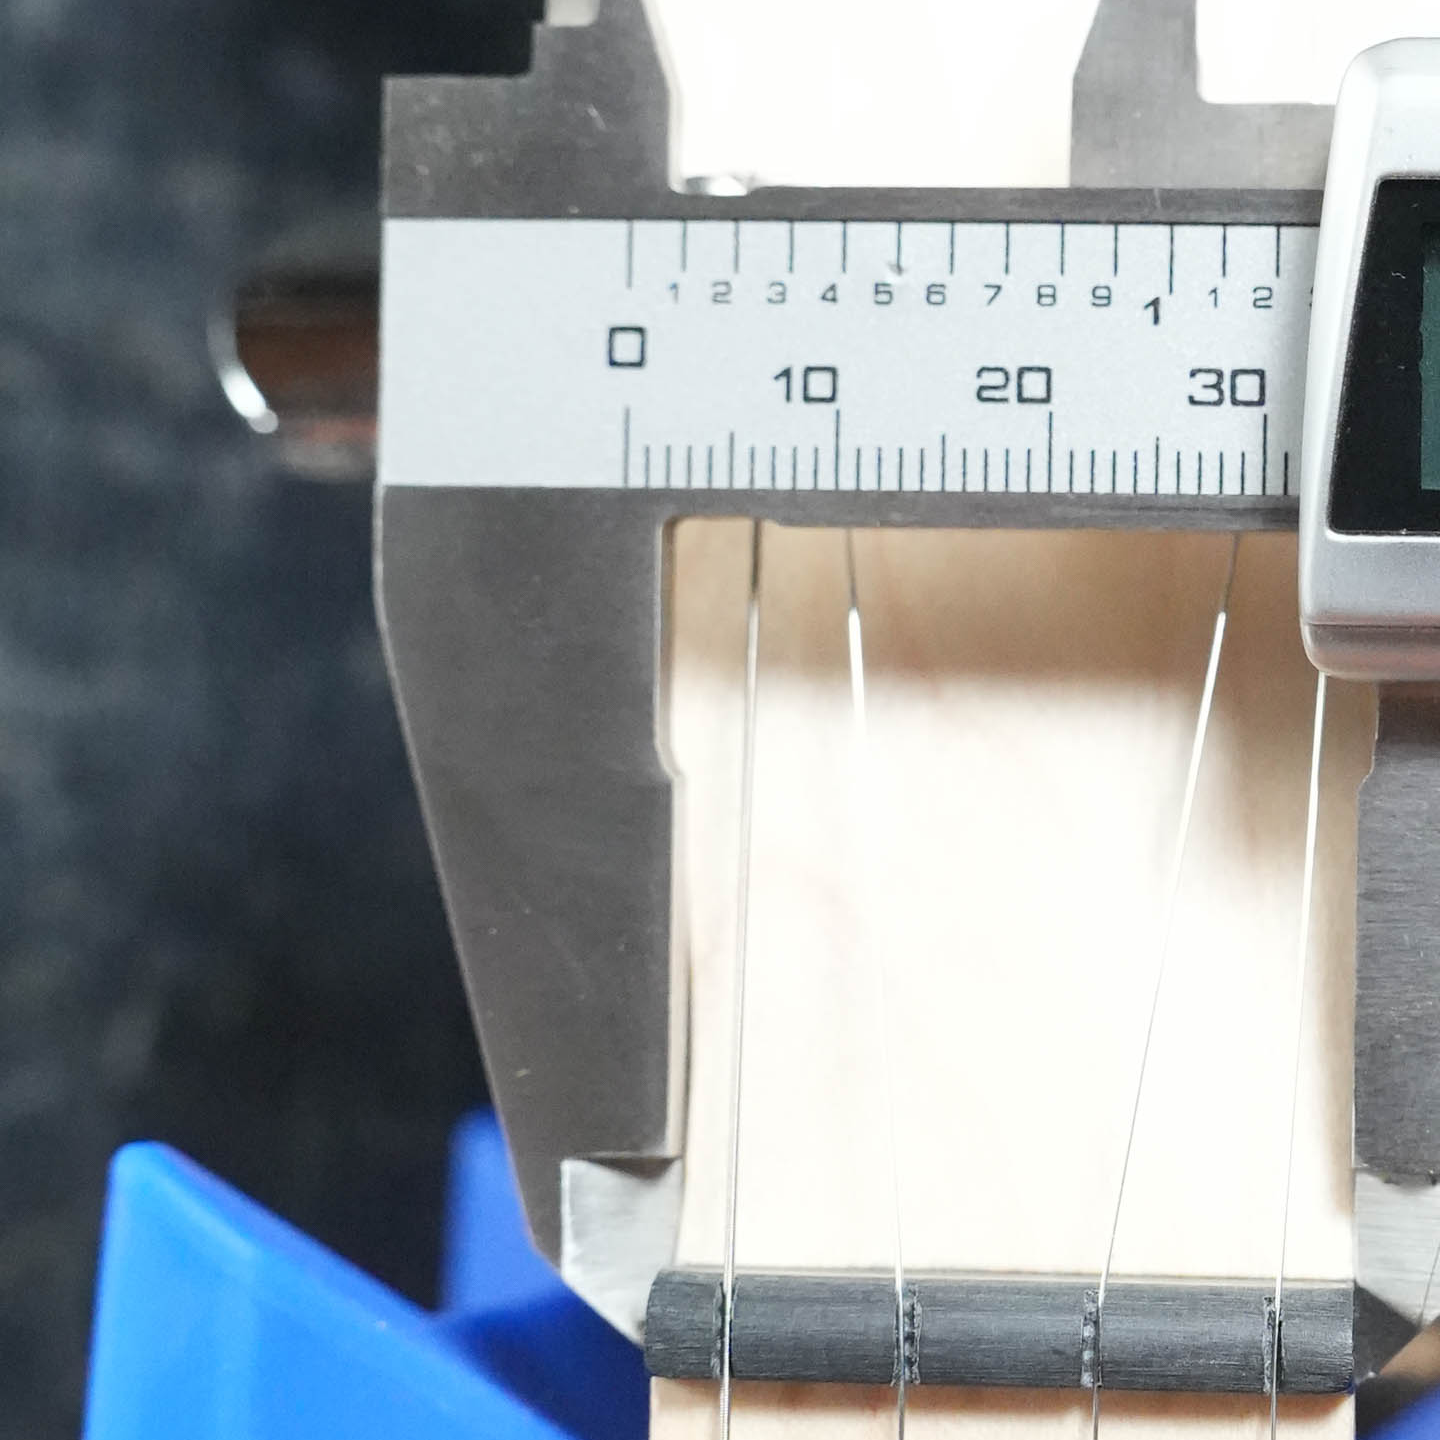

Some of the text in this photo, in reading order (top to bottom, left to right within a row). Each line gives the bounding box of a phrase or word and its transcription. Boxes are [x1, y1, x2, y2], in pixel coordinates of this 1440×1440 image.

[669, 282, 1273, 326] 1 2 3 4 5 6 7 8 9 1 1 2
[608, 326, 646, 368] 0
[773, 366, 1267, 408] 10 20 30
